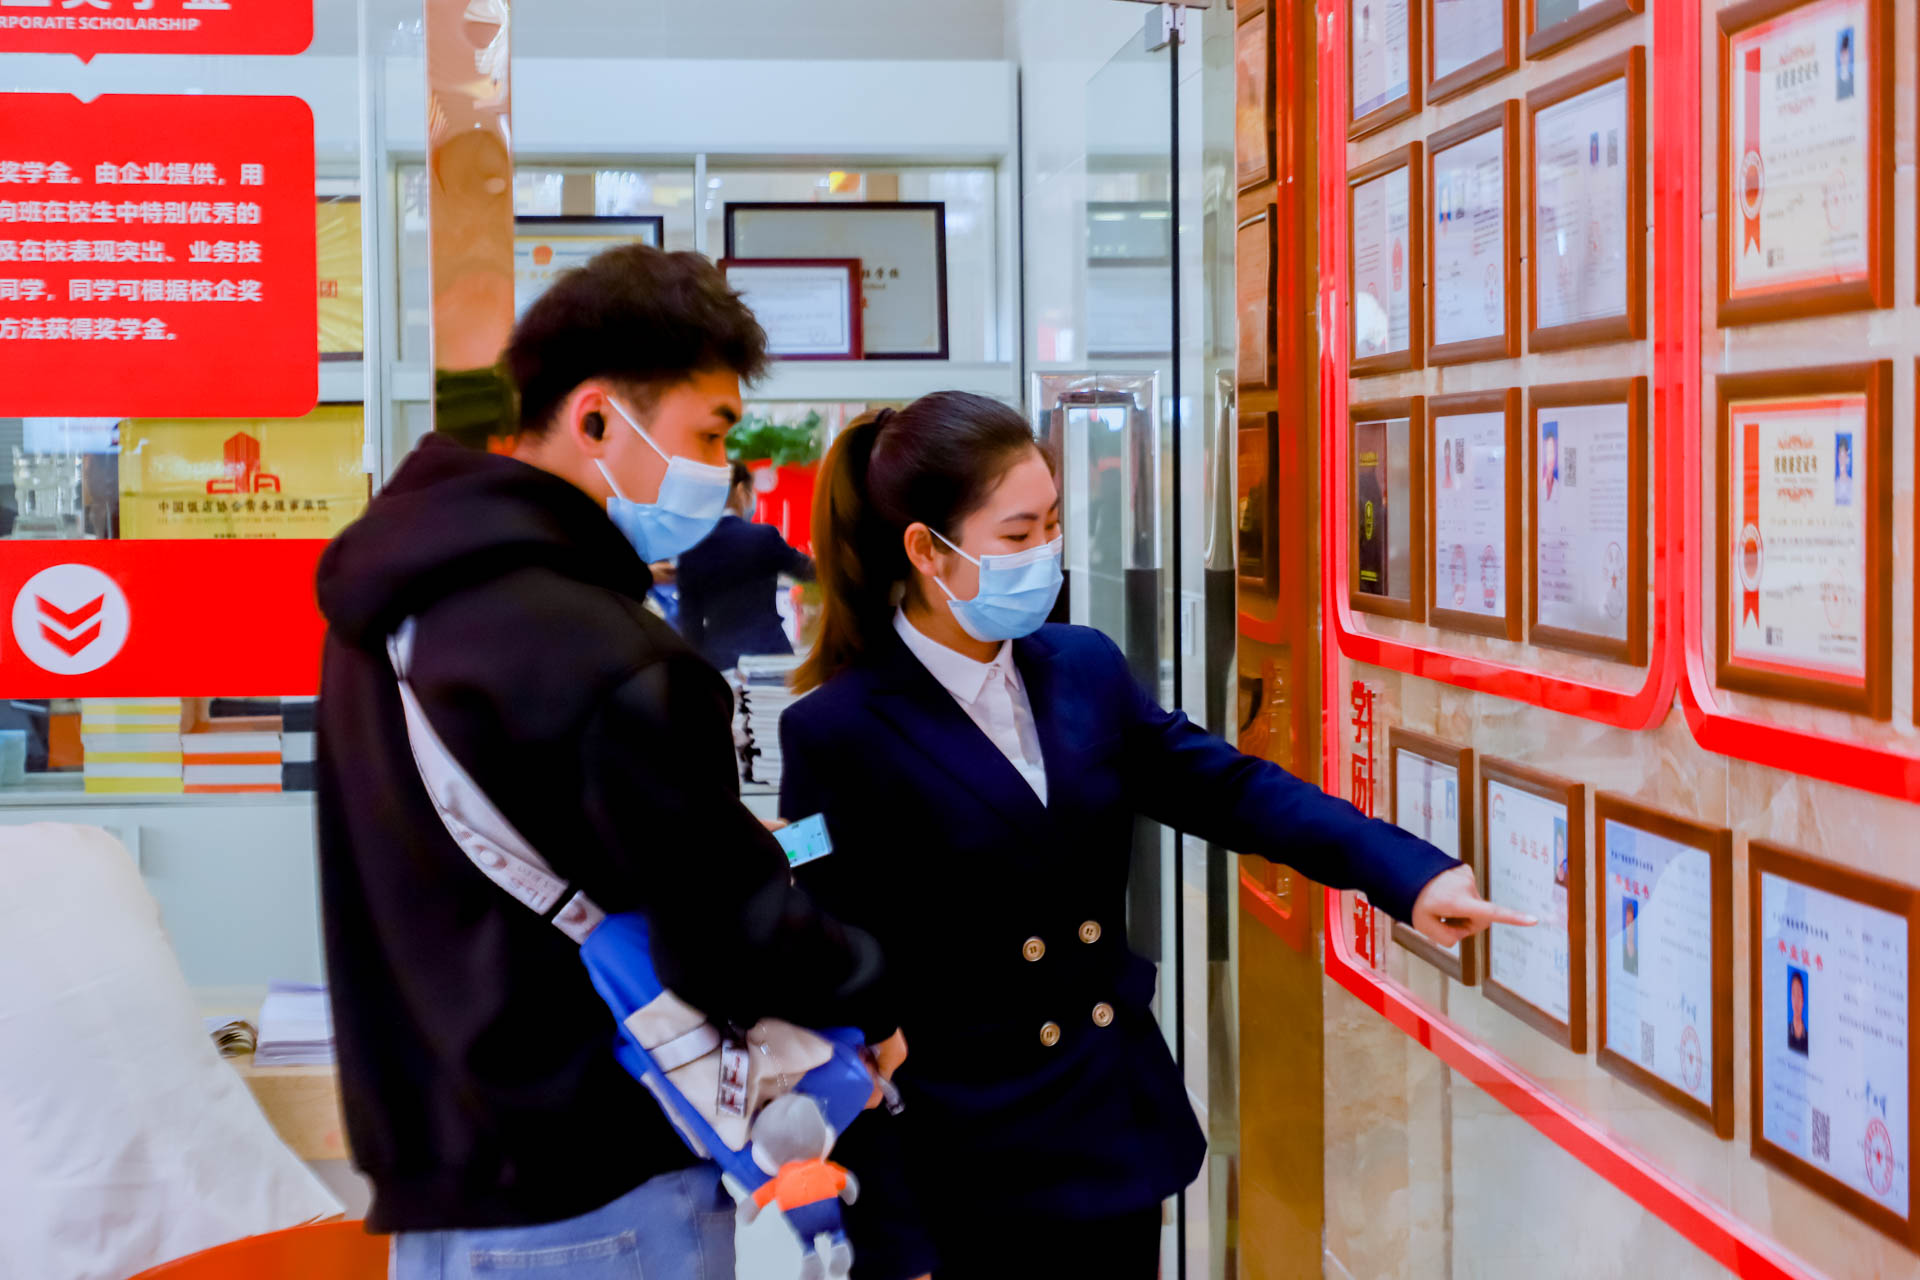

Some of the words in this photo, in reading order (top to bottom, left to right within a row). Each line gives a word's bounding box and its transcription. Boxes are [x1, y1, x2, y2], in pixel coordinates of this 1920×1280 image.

[78, 16, 201, 31] SCHOLARSHIP
[0, 200, 261, 225] 向班在校生中特别优秀的
[0, 239, 263, 263] 及在校表现突出、业务技
[0, 278, 263, 302] 同学，同学可根据校企奖
[0, 317, 177, 341] 方法获得奖学金。
